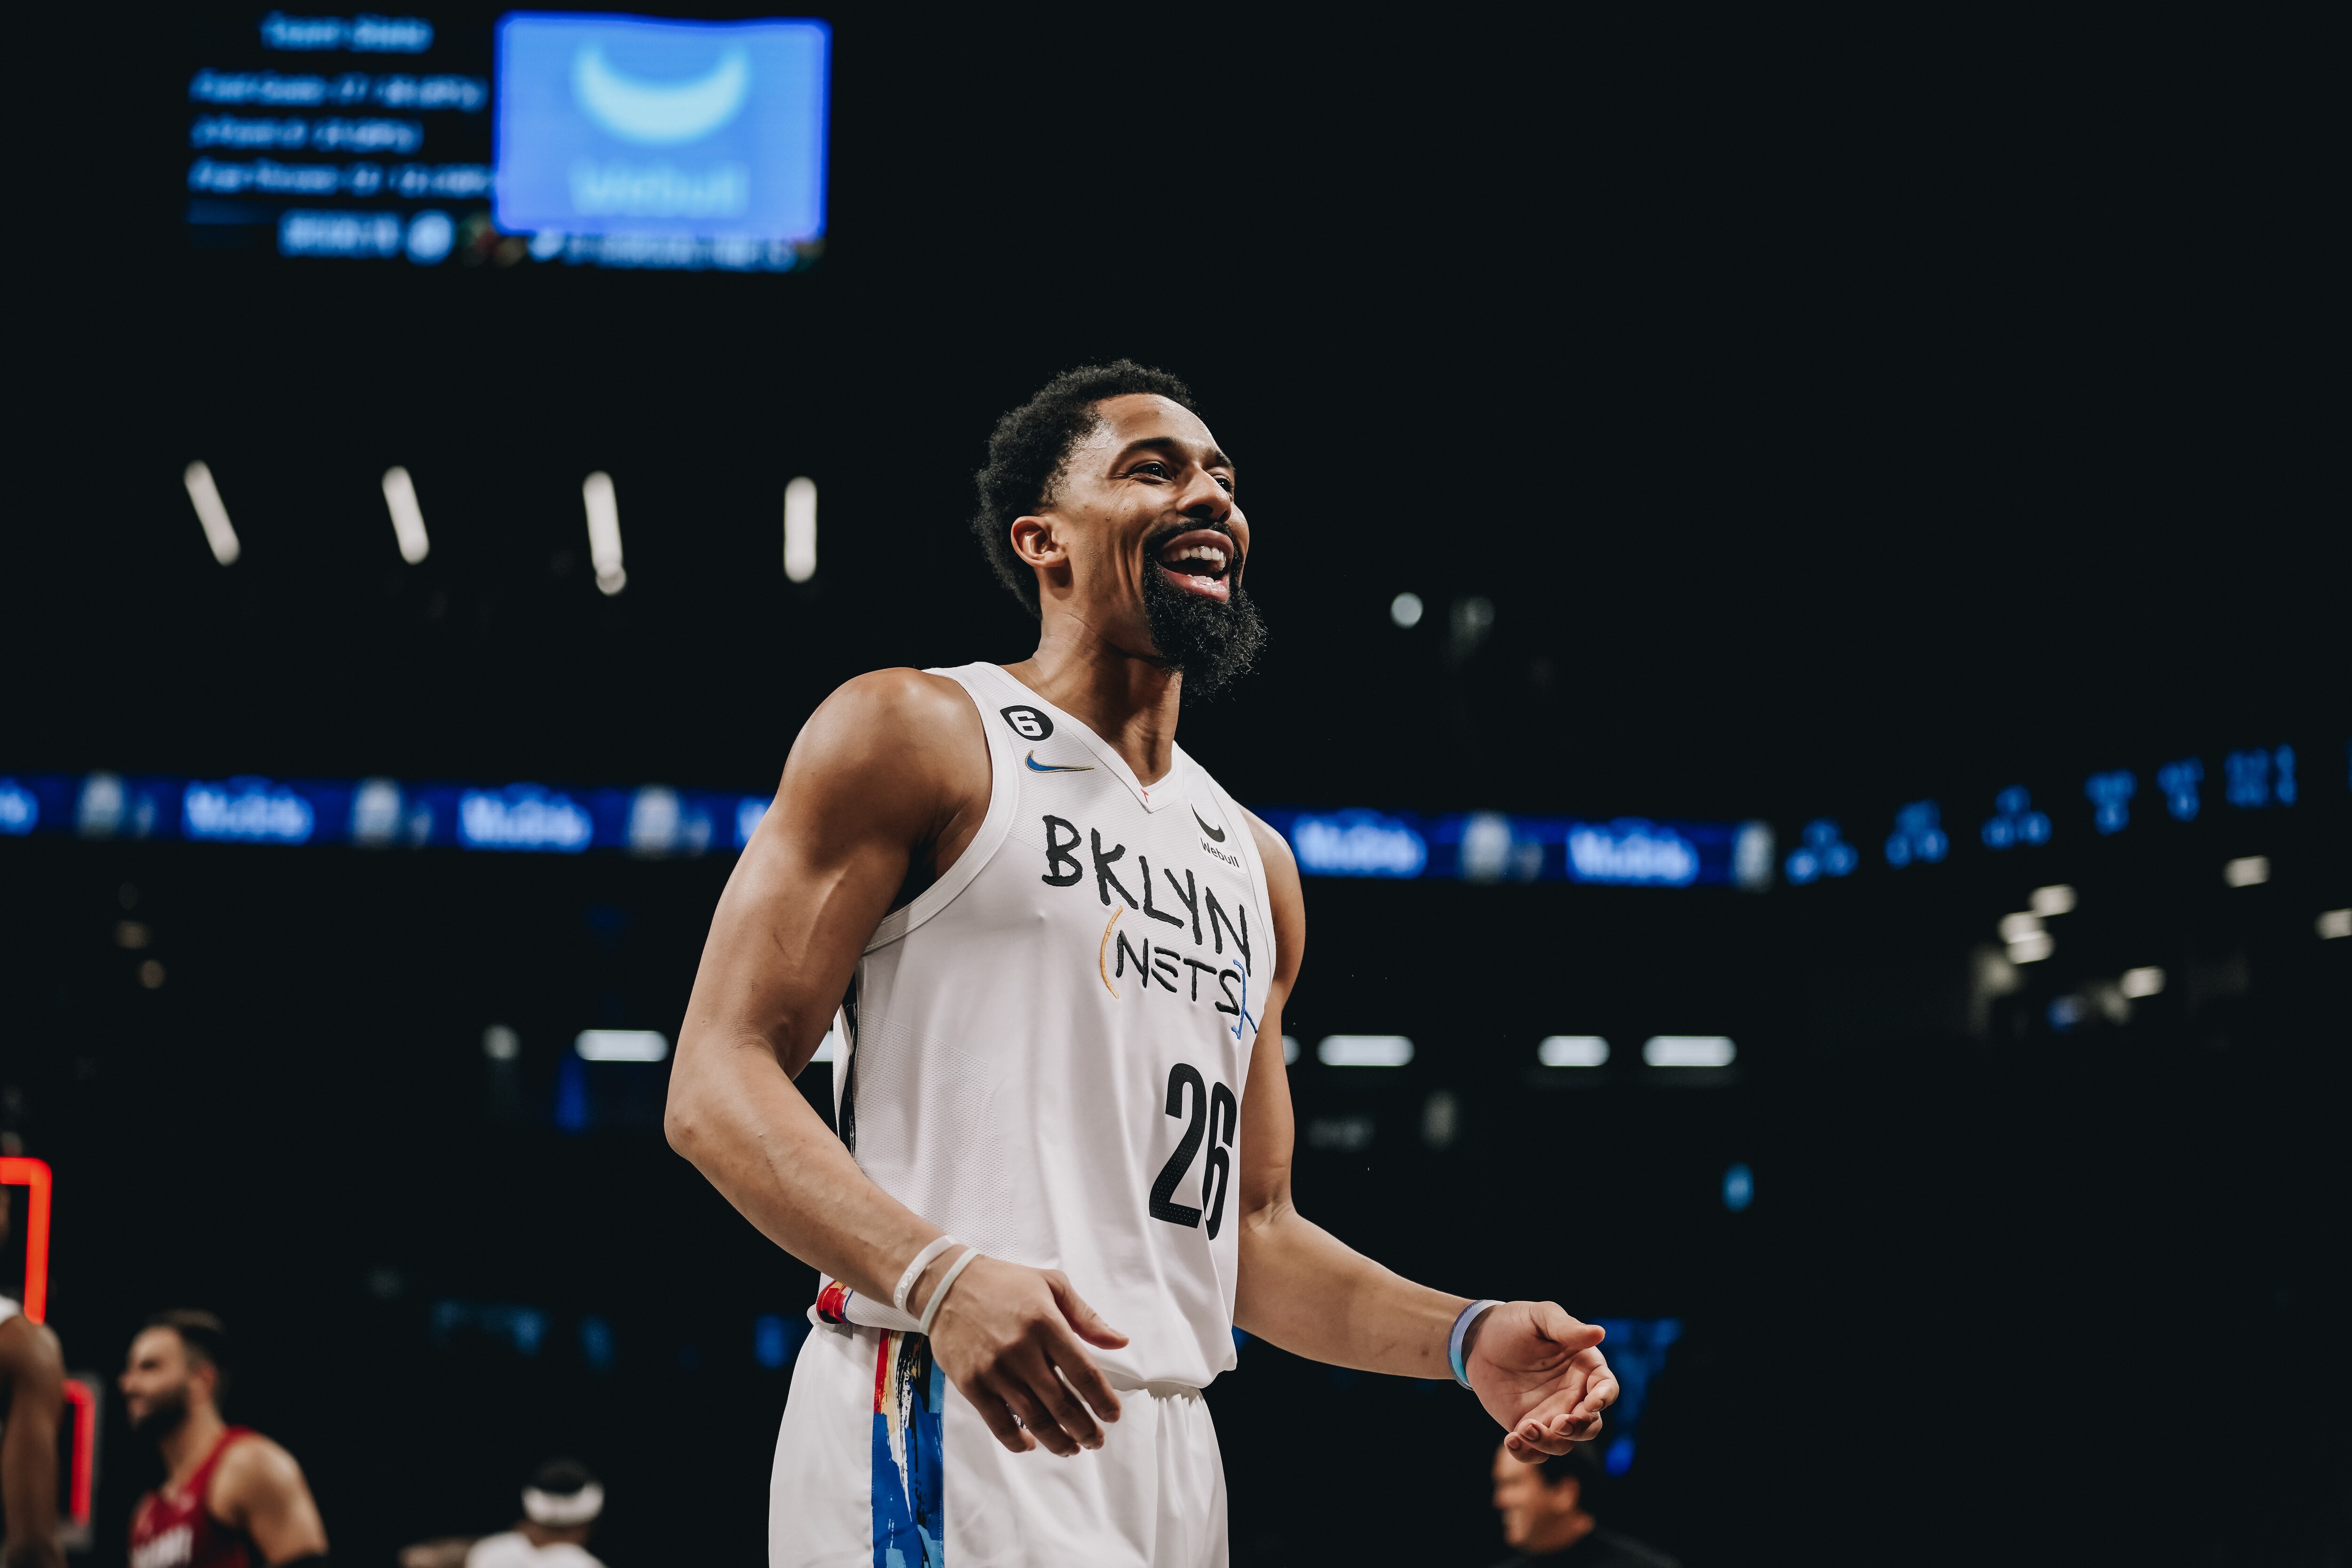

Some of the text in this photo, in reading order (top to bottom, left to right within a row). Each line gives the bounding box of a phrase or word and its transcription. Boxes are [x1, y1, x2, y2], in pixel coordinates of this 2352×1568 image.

[1009, 710, 1043, 736] 6
[1041, 814, 1252, 977] BKLYN
[1200, 837, 1240, 868] Webull
[1149, 1063, 1238, 1241] 26
